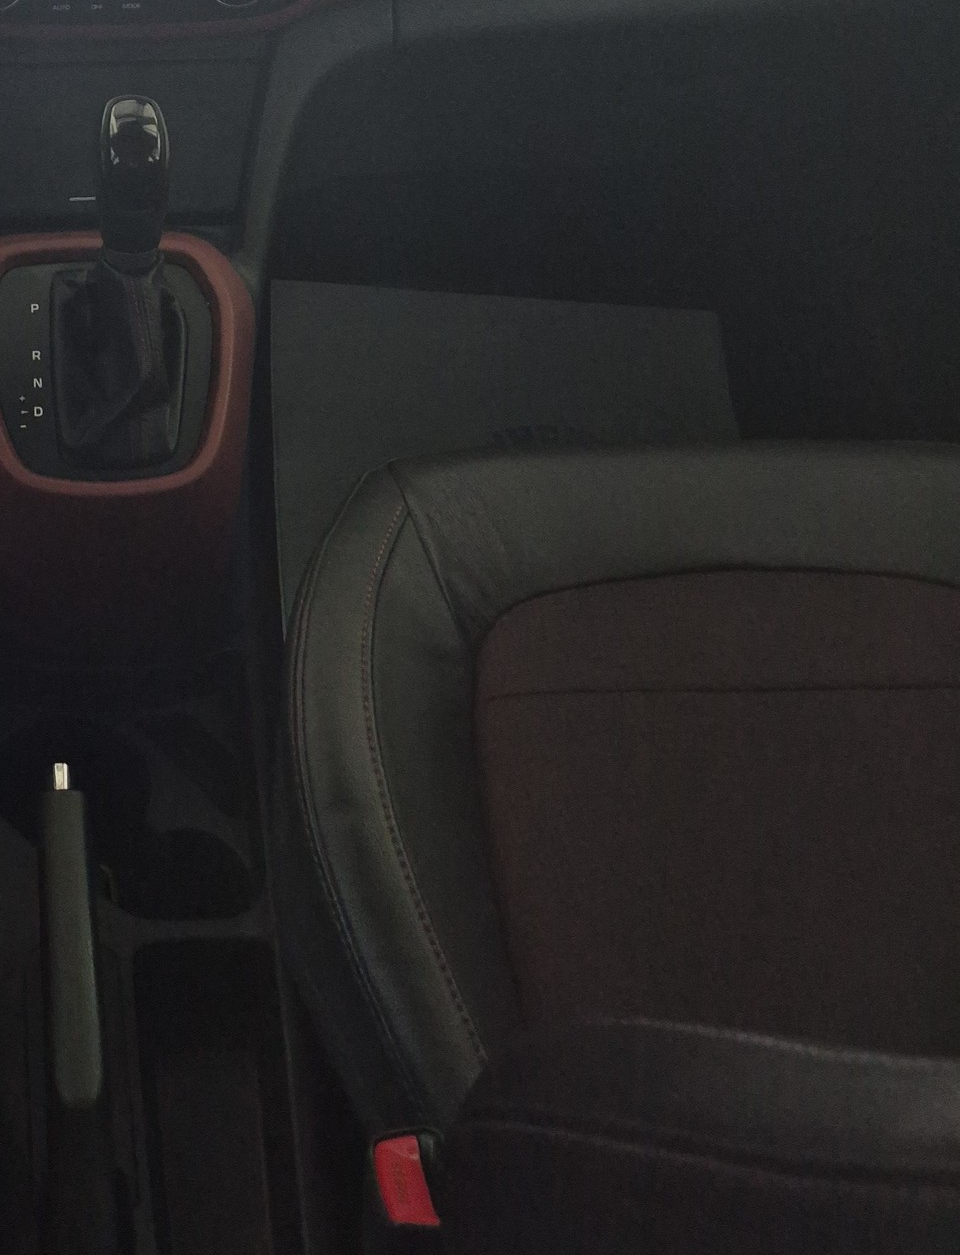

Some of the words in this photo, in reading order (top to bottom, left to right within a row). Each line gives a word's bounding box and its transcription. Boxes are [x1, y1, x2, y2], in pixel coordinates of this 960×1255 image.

[30, 303, 40, 313] P
[32, 350, 41, 361] R
[33, 377, 43, 388] N
[33, 406, 44, 417] D
